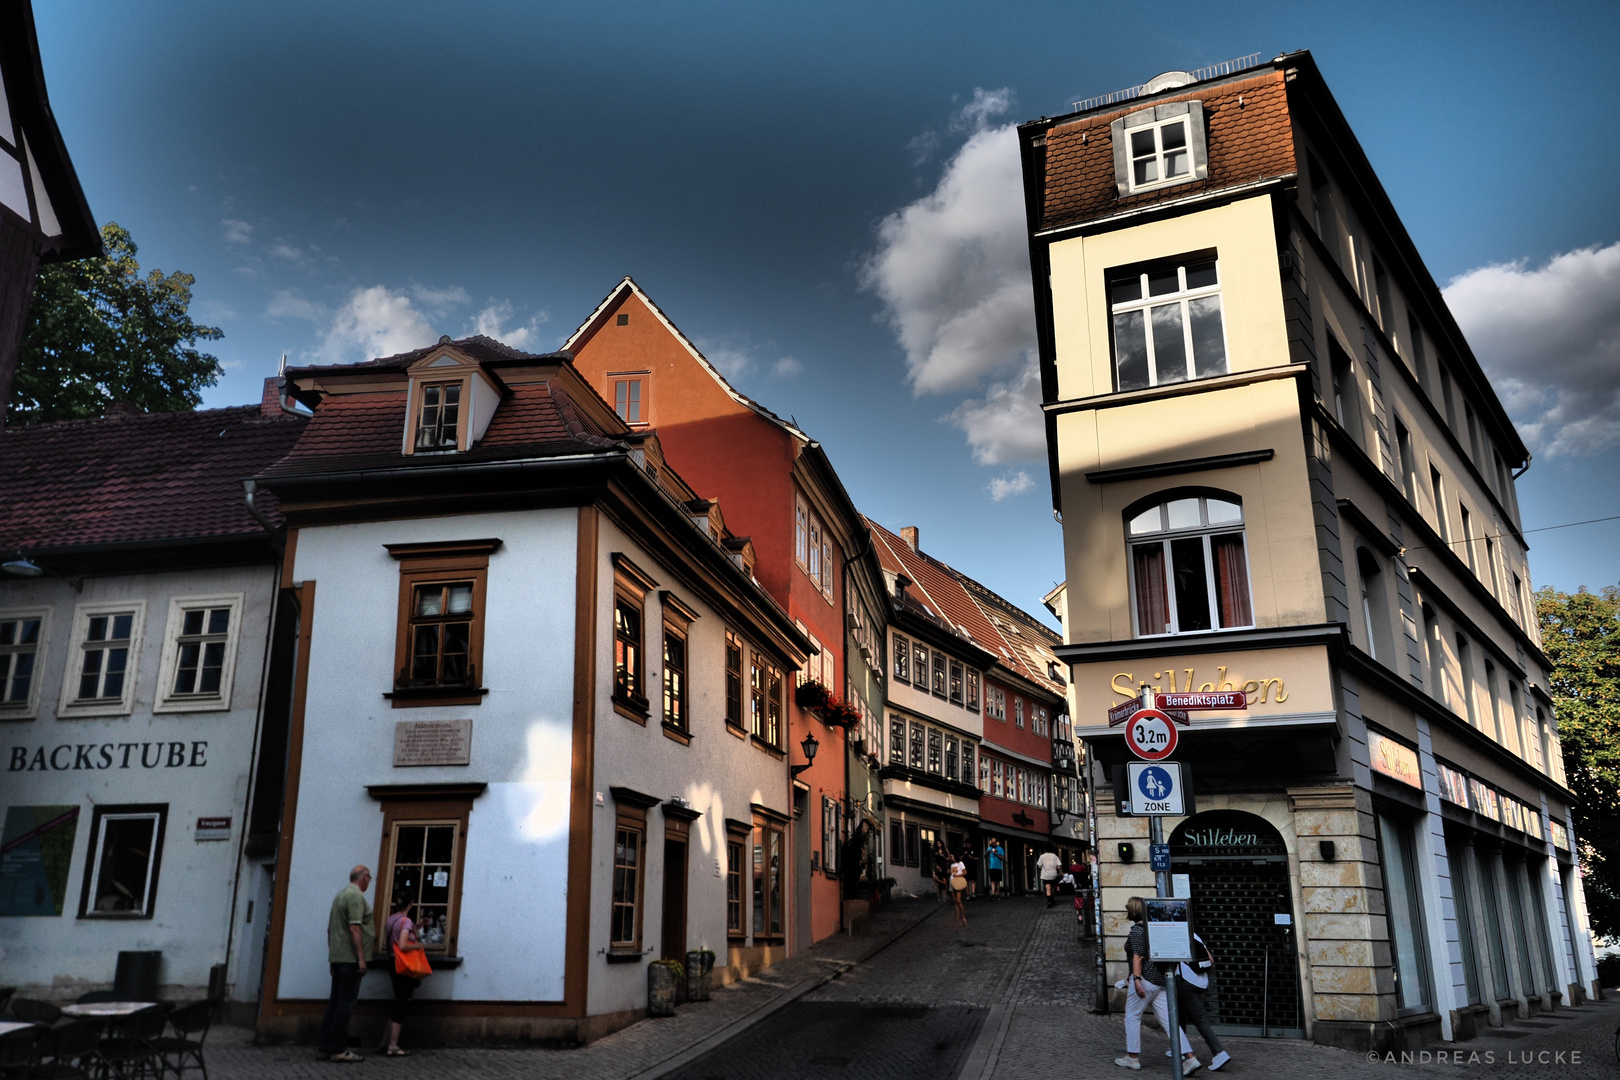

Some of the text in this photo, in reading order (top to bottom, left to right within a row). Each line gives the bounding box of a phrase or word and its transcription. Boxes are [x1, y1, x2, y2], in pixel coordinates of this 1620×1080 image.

[1166, 694, 1234, 707] Benediktsplatz
[7, 741, 208, 772] BACKSTUBE
[1144, 802, 1171, 811] ZONE
[1184, 828, 1258, 846] Stilleben
